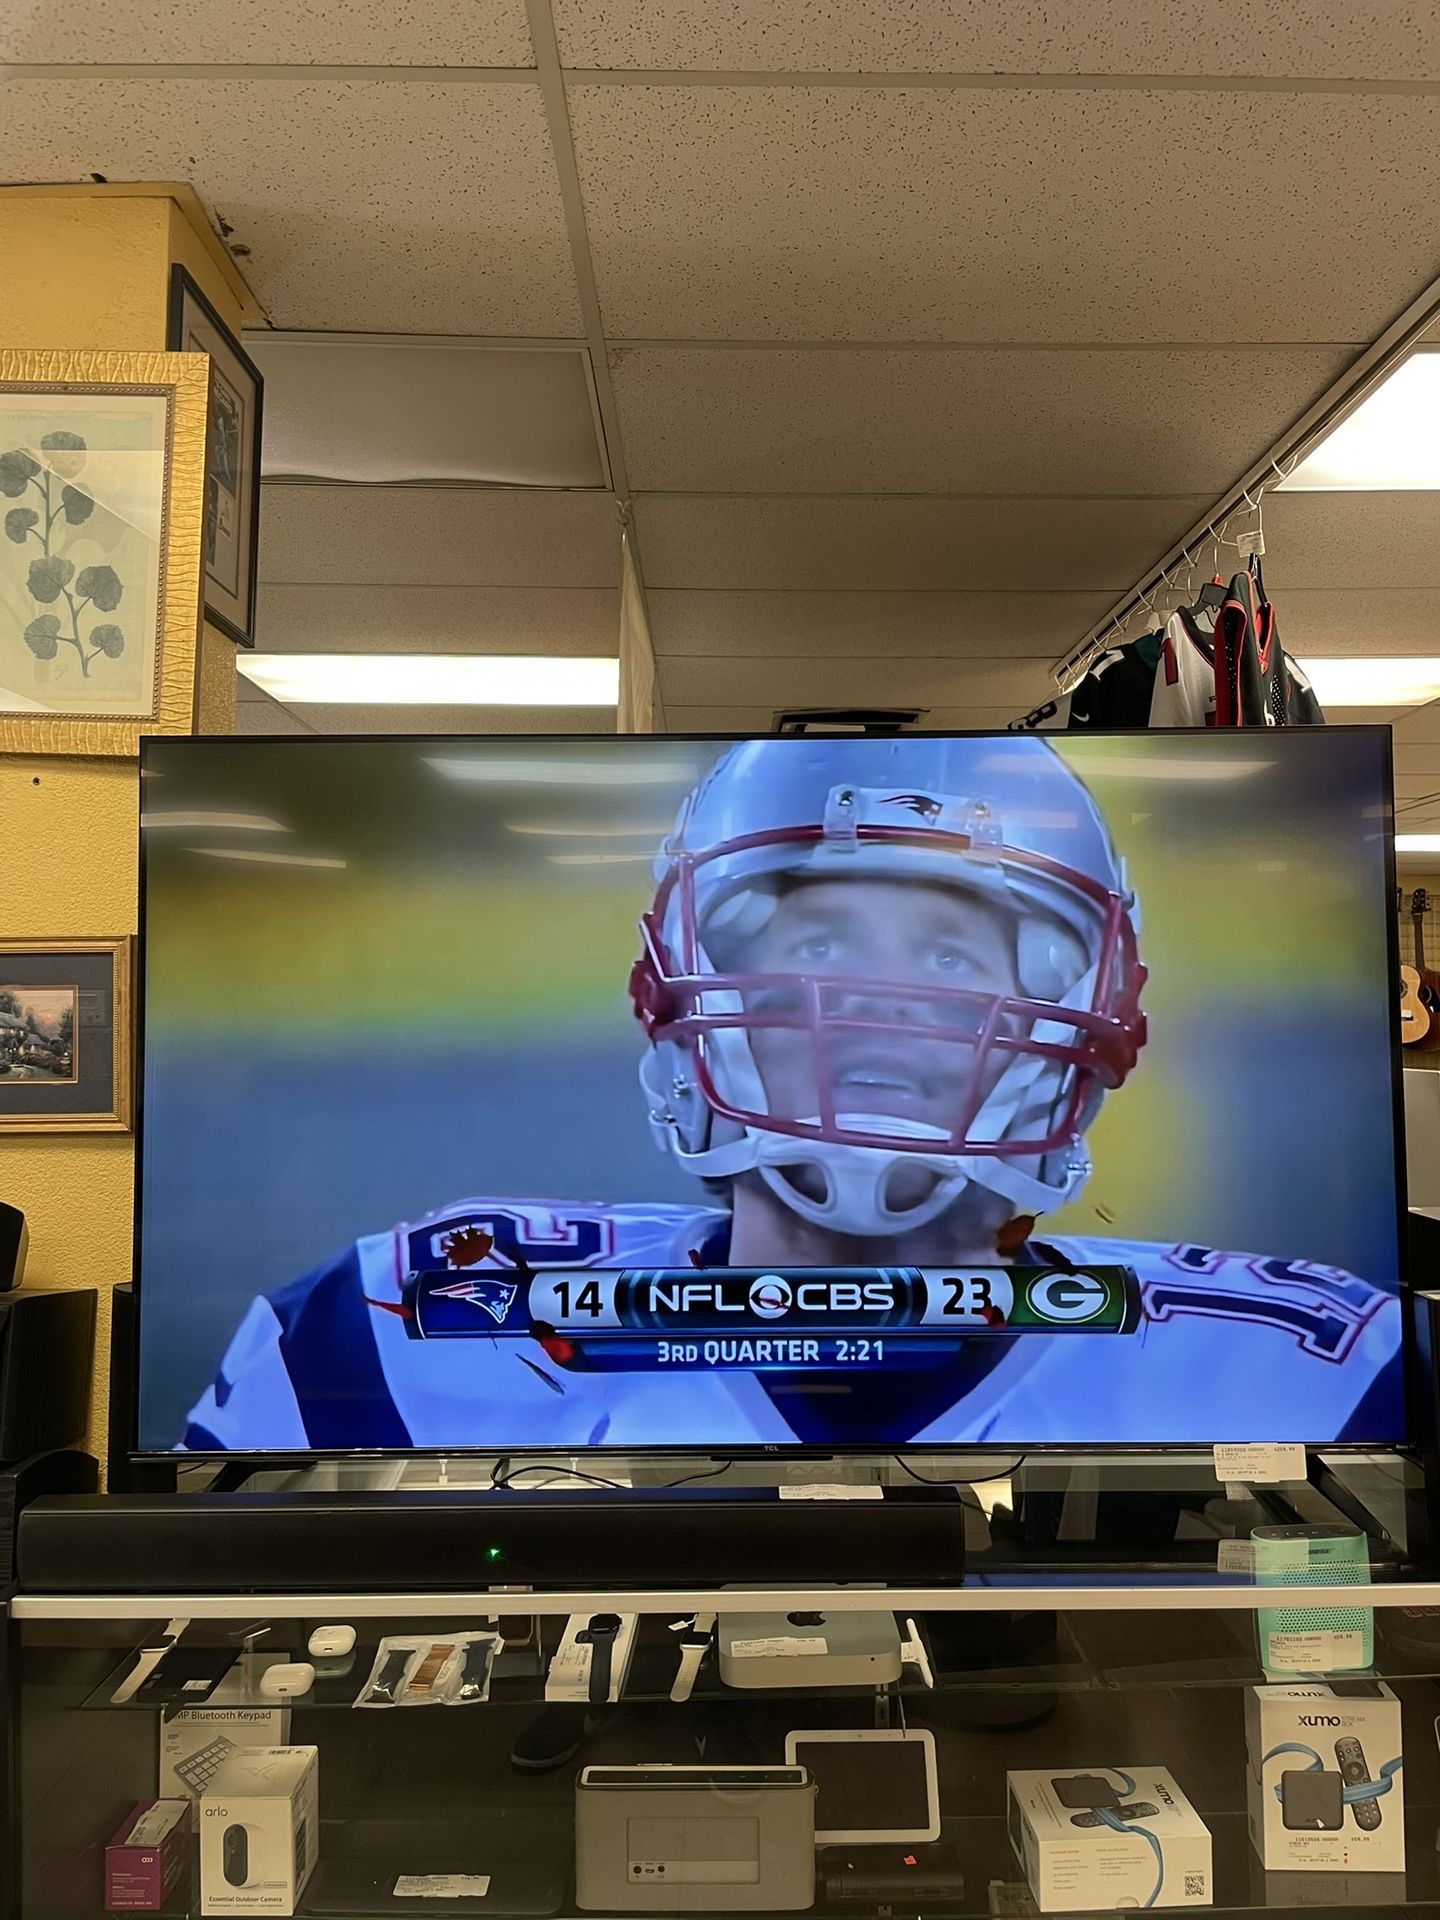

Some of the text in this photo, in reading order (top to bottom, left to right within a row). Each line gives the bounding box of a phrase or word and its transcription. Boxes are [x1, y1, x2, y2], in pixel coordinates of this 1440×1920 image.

[552, 1281, 604, 1319] 14
[649, 1283, 895, 1312] NFL CBS
[942, 1277, 994, 1316] 23
[657, 1340, 884, 1365] 3RD QUARTER 2:21
[191, 1710, 236, 1720] Bluetooth
[237, 1710, 272, 1721] Keypad
[1297, 1715, 1341, 1727] xumo
[205, 1806, 228, 1817] arlo
